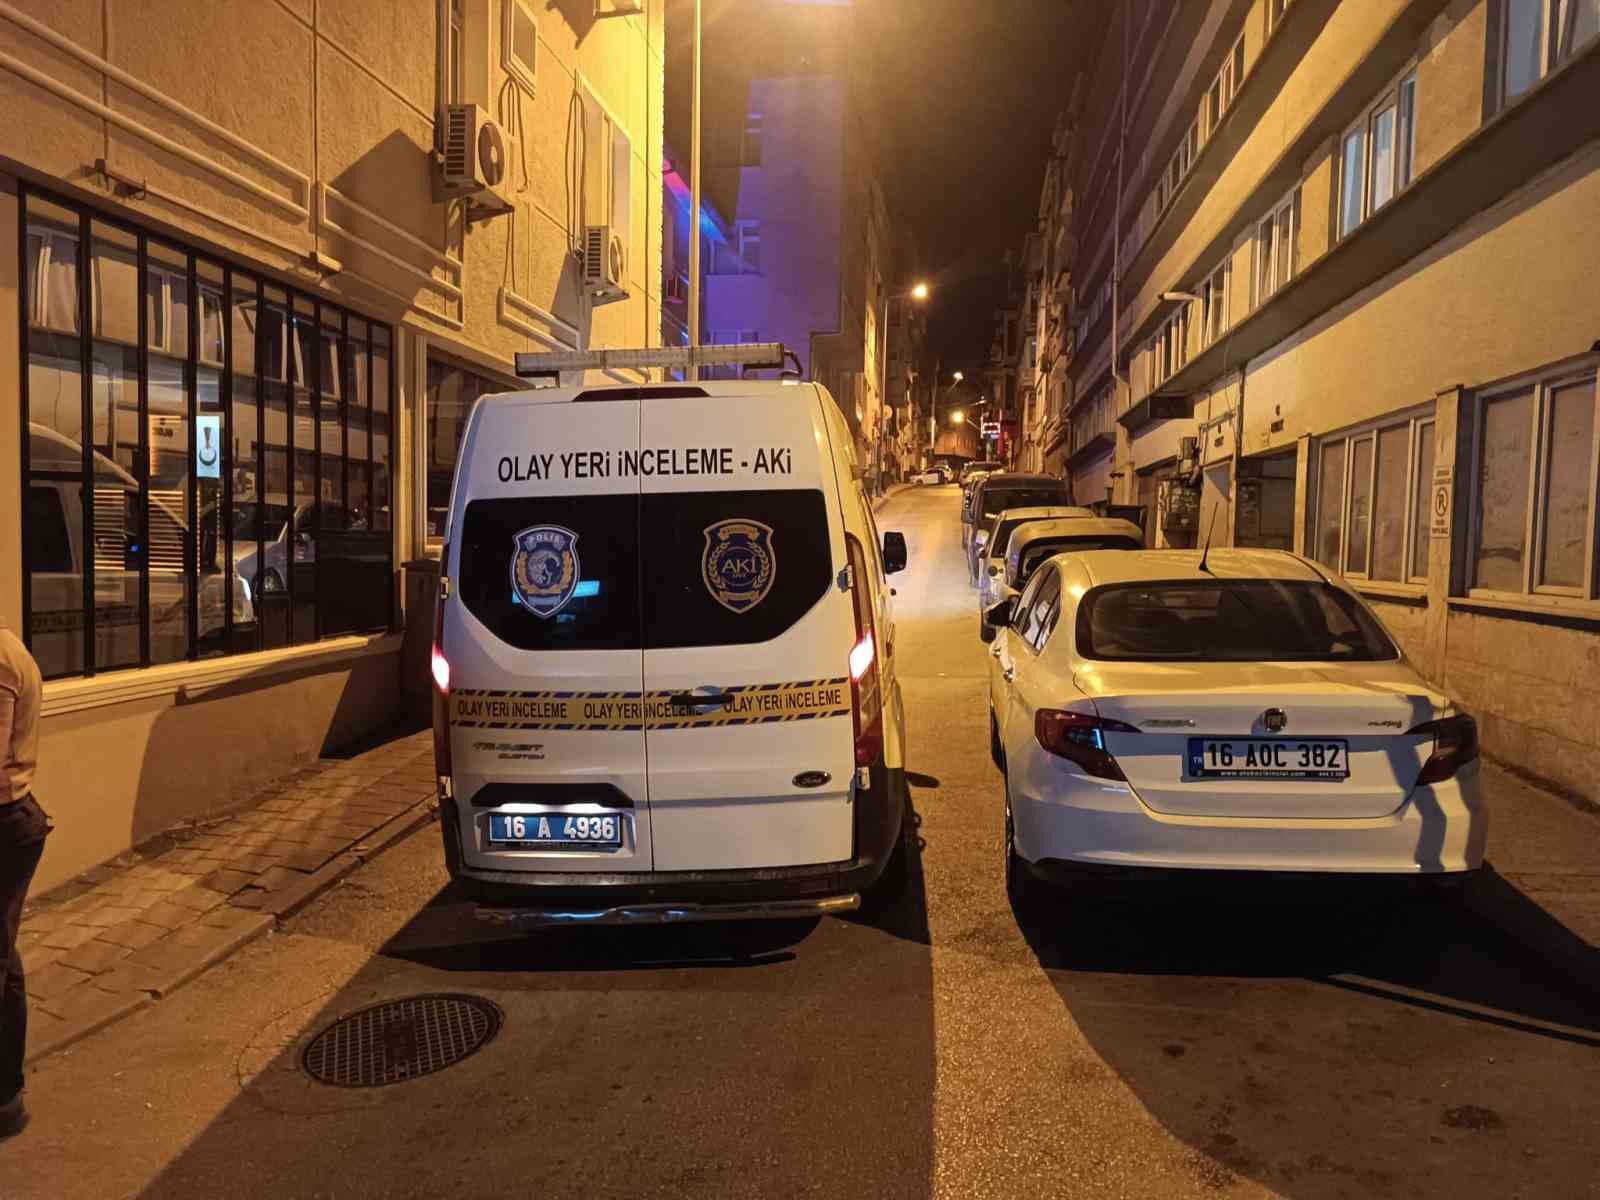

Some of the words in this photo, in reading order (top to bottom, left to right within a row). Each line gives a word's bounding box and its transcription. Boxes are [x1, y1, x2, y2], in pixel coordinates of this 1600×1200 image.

[498, 453, 554, 482] OLAY
[458, 701, 483, 716] OLAY
[584, 702, 614, 719] OLAY
[1208, 743, 1233, 768] 16
[1245, 744, 1288, 768] AOC
[1297, 744, 1341, 768] 382
[504, 815, 526, 838] 16
[537, 816, 552, 839] A
[563, 816, 615, 840] 4936
